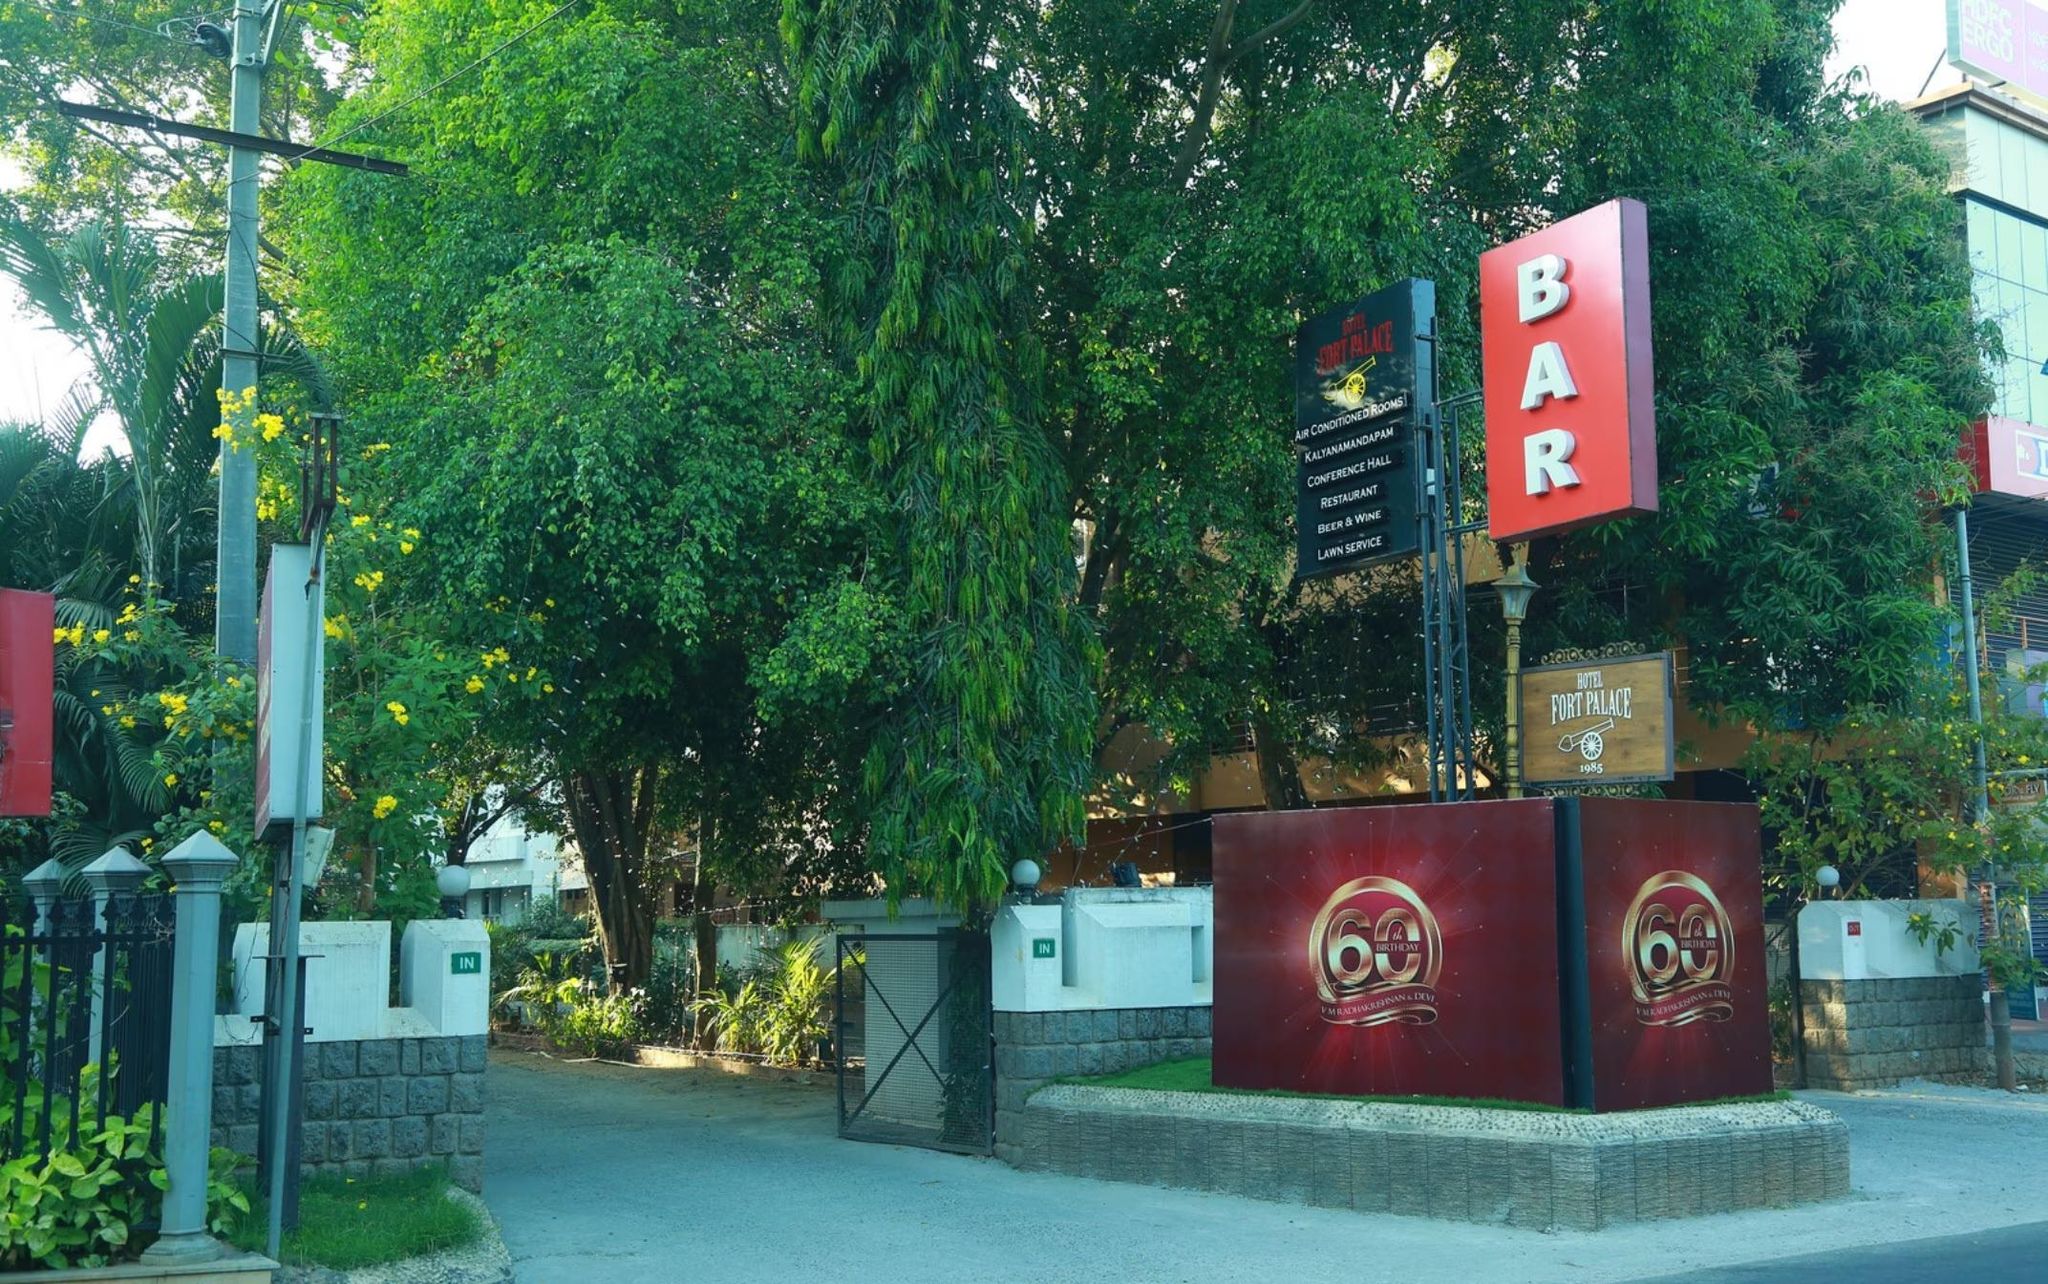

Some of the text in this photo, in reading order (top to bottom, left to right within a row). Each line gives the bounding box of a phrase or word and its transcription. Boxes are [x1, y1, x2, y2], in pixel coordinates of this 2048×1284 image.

[1963, 17, 2015, 64] ERGO
[1350, 320, 1393, 358] PALACE
[1516, 253, 1581, 497] BAR
[1310, 408, 1369, 436] CONDITIONED
[1370, 396, 1405, 416] ROOMS
[1304, 427, 1394, 464] KALYANAMANDAPAM
[1307, 454, 1393, 488] CONFERENCE HALL
[1320, 484, 1379, 509] RESTAURANT
[1317, 510, 1382, 534] BEER & WINE
[1317, 536, 1383, 561] LAWN SERVICE
[1576, 670, 1604, 690] HOTEL
[1551, 687, 1632, 726] FORT PALACE
[1579, 763, 1604, 774] 1985
[1039, 943, 1051, 954] IN
[1327, 908, 1422, 985] 60
[1375, 943, 1420, 953] BIRTHDAY
[1639, 903, 1719, 984] 60
[460, 957, 475, 969] IN
